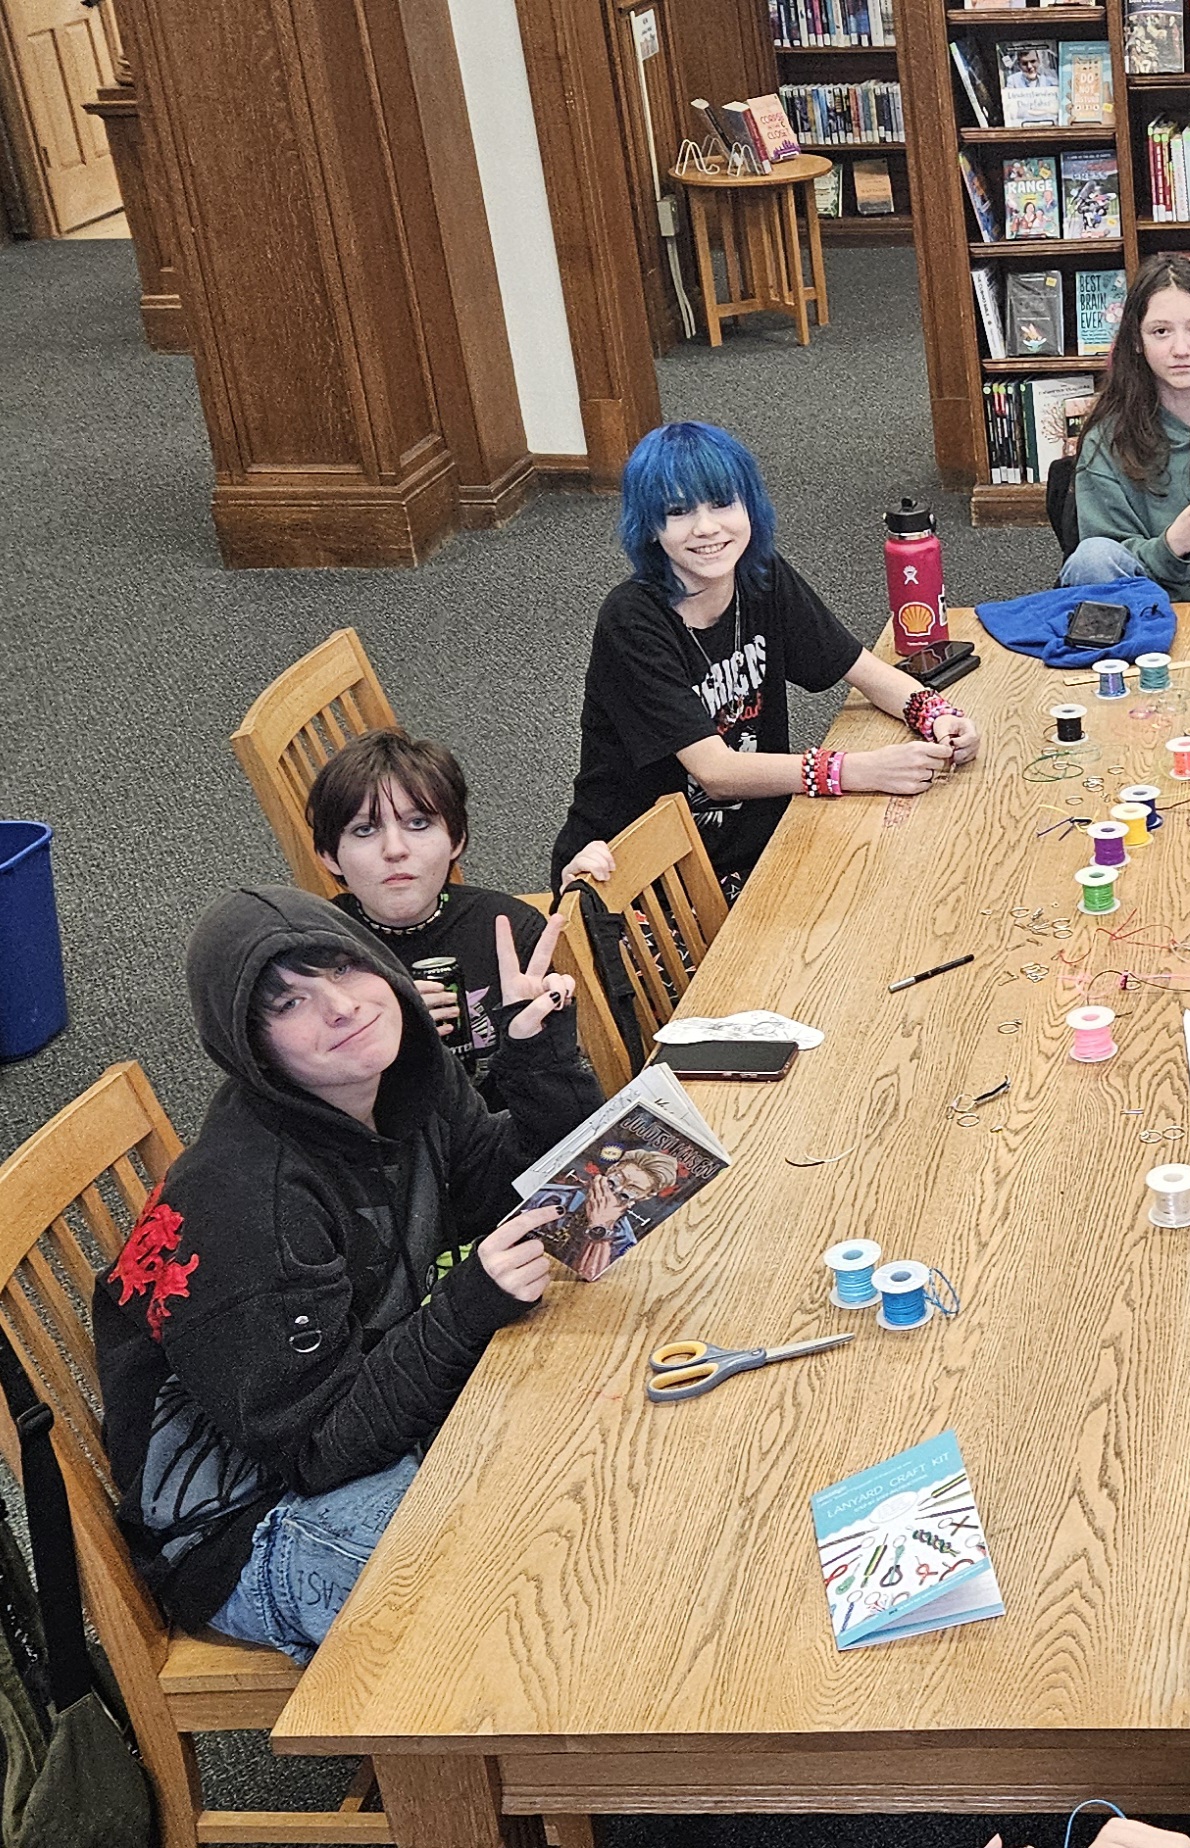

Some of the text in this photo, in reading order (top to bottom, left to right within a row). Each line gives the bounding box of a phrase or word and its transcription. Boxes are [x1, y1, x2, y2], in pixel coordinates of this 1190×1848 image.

[1080, 73, 1094, 83] DO
[1079, 85, 1094, 94] NOT
[1080, 275, 1102, 292] BEST
[1080, 293, 1106, 311] BRAIN
[1081, 312, 1103, 329] EVER
[619, 1115, 721, 1179] JUJUTSU KAISEN
[827, 1485, 884, 1519] LANYARD
[889, 1463, 927, 1487] CRAFT
[932, 1451, 950, 1468] KIT
